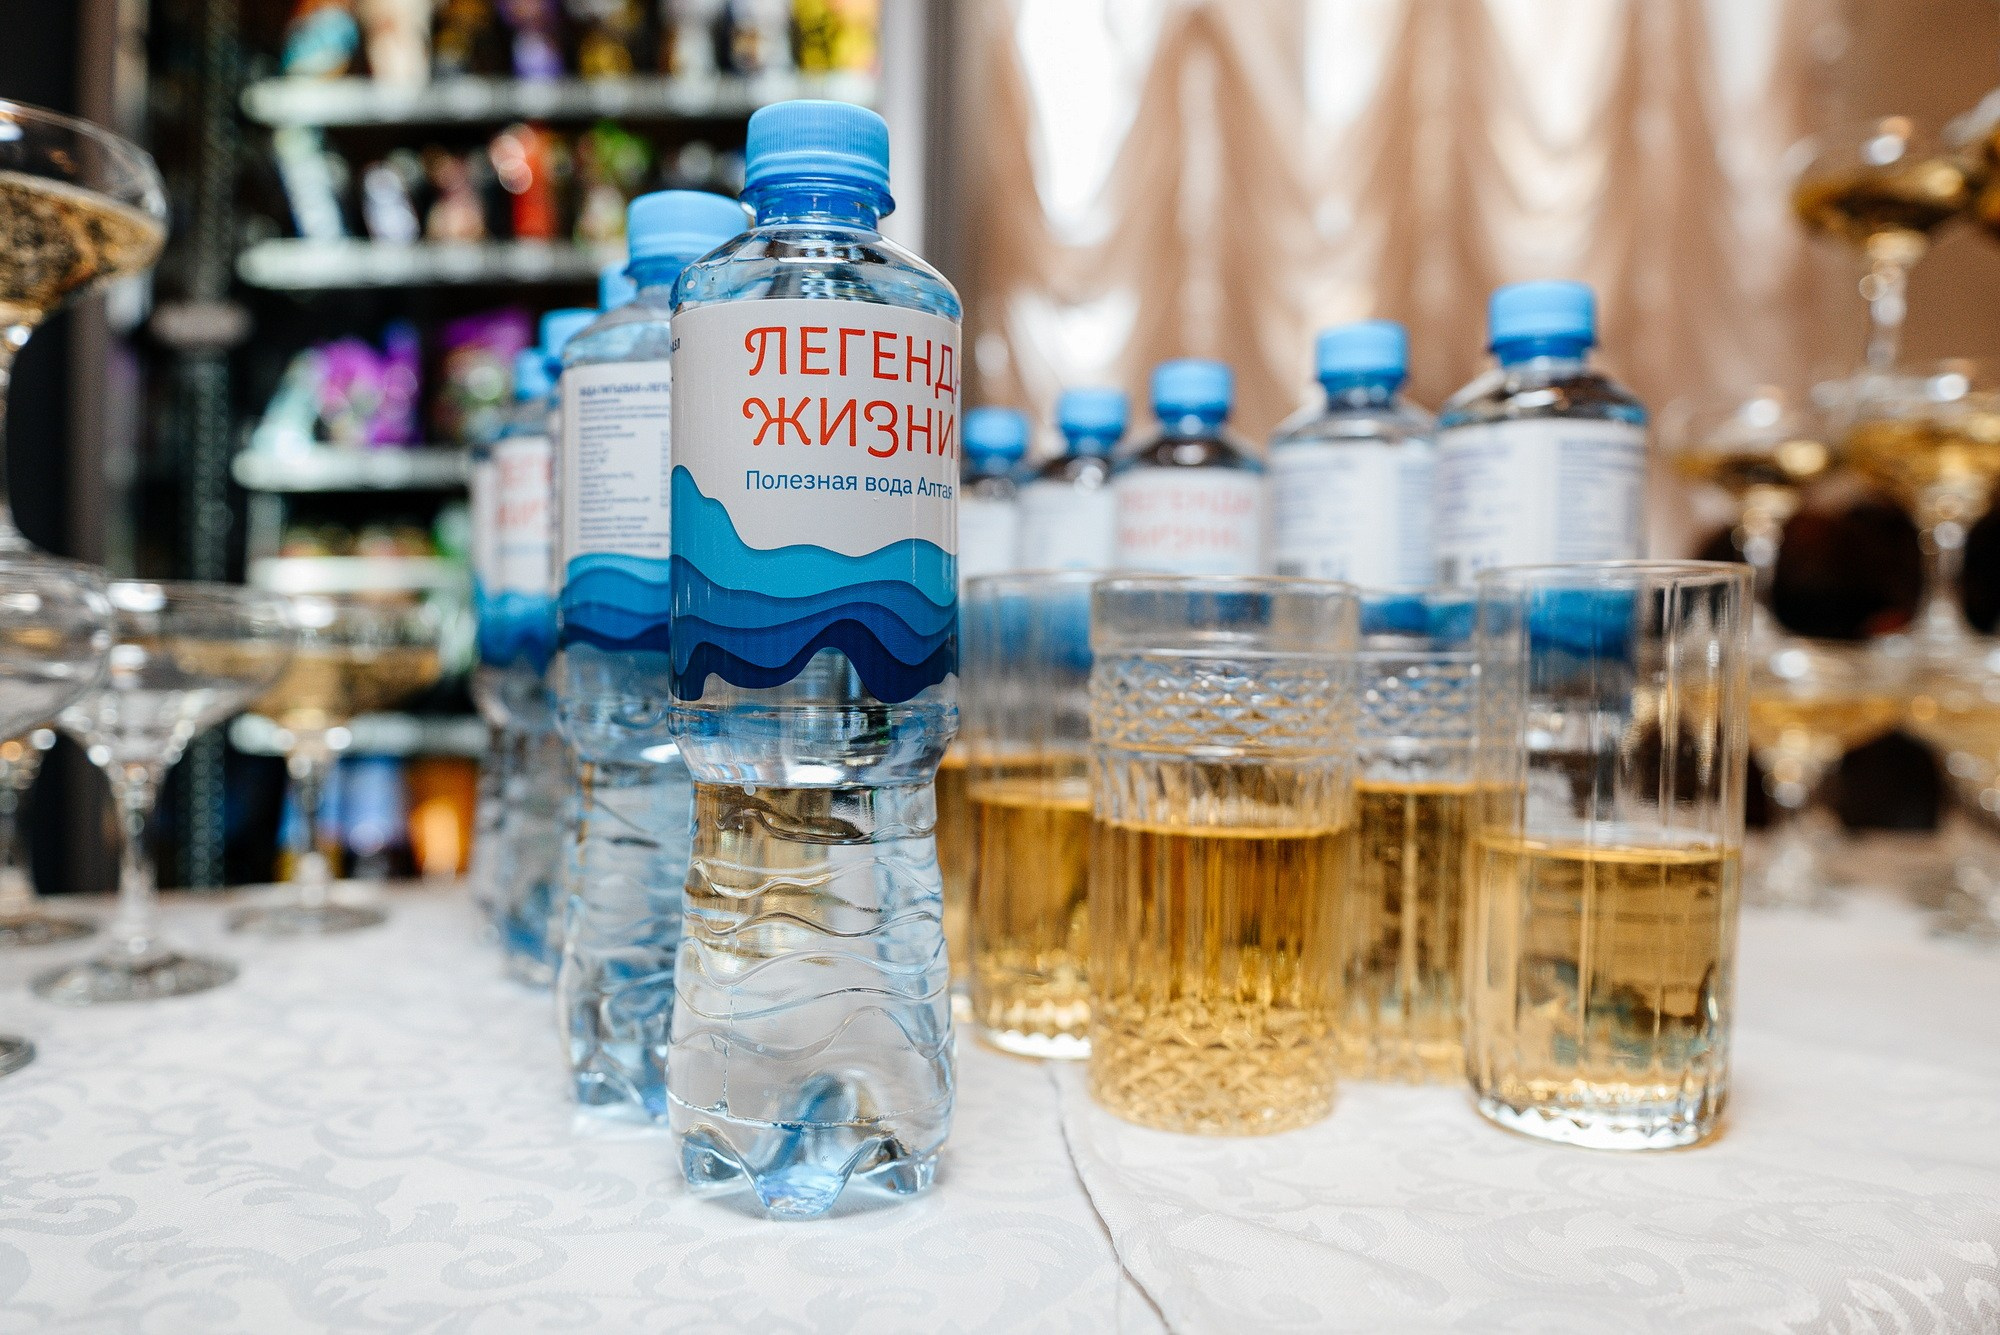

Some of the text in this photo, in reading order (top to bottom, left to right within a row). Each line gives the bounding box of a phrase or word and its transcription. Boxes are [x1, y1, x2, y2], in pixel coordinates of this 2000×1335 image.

[743, 326, 957, 404] ЛЕГЕНД
[742, 396, 955, 460] ЖИЗНИ
[745, 470, 952, 500] Полезная вода Алтая
